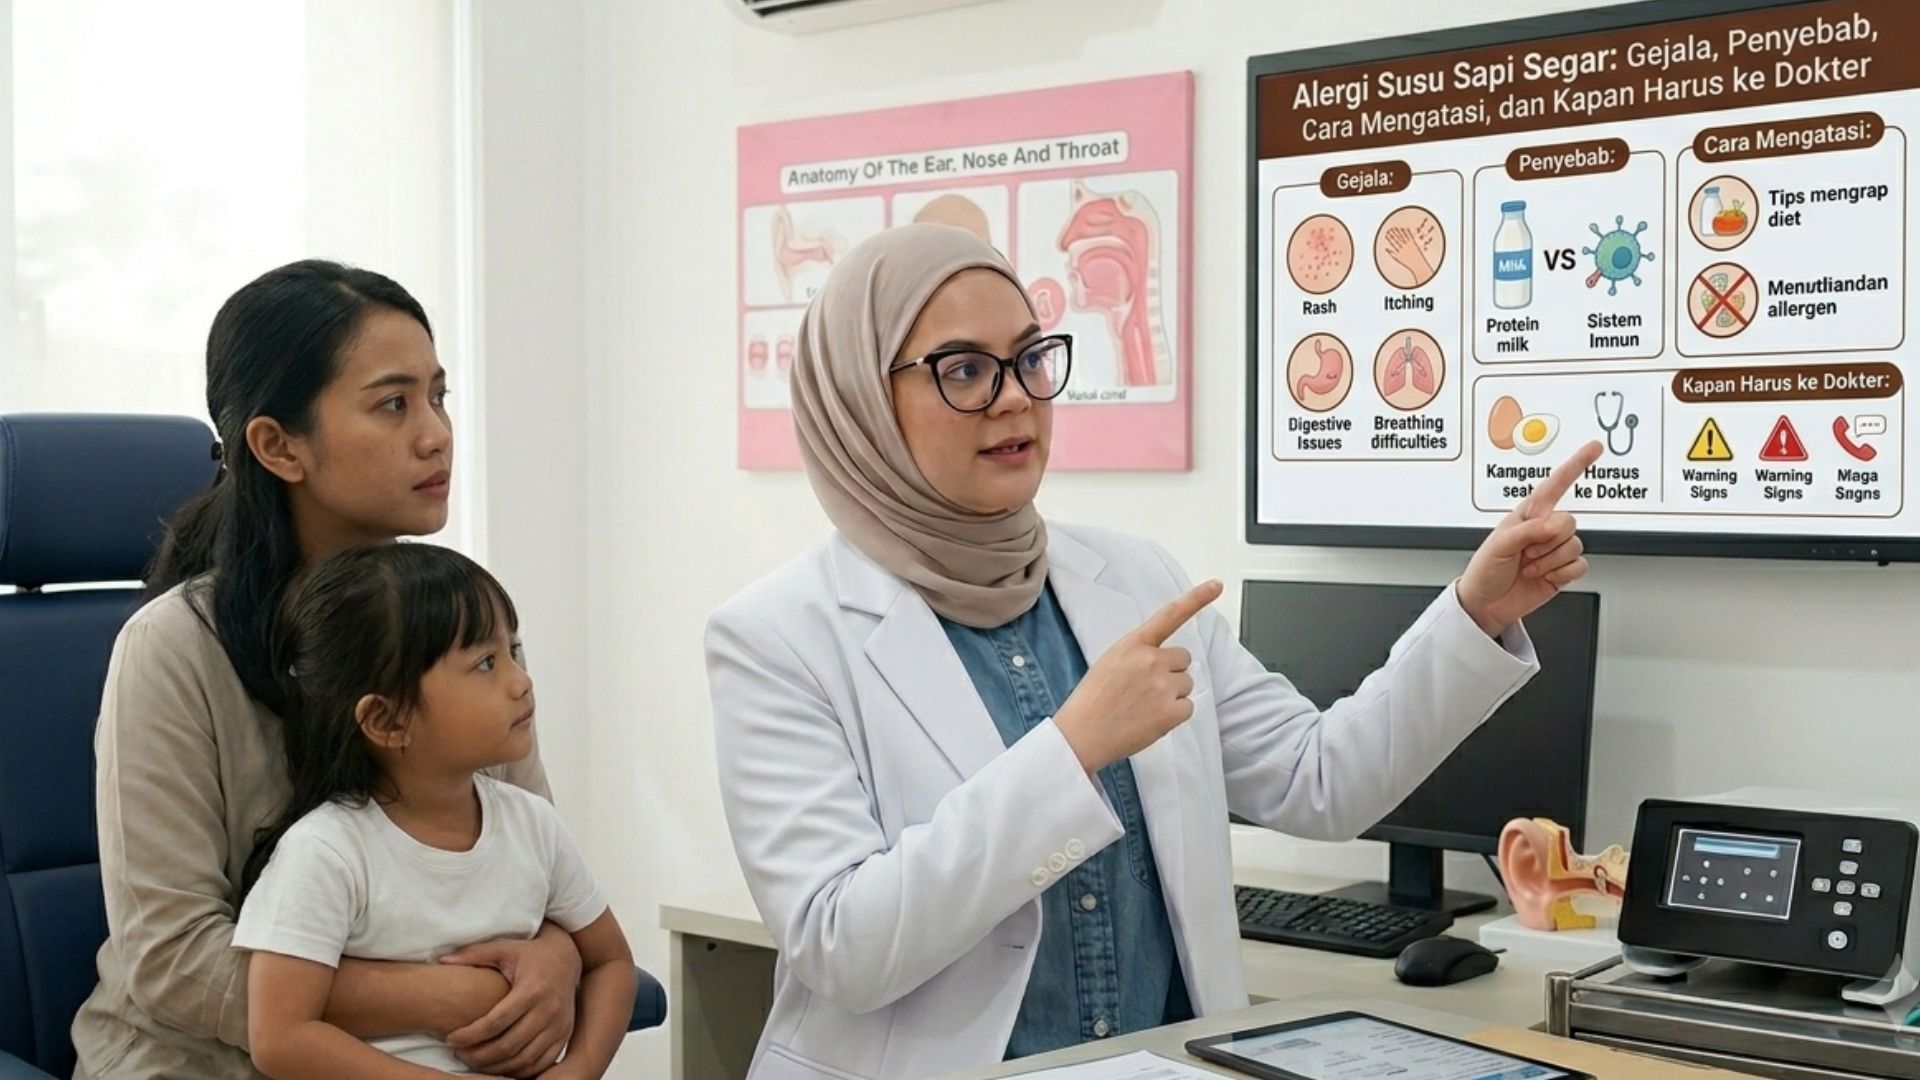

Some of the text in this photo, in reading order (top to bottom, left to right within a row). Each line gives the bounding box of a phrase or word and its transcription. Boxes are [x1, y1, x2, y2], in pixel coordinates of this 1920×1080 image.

[1292, 12, 1878, 111] Alergi Susu Sapi Segar: Gejala, Penyebab,
[1302, 56, 1872, 142] Cara Mengatasi, dan Kapan Harus ke Dokter
[1704, 119, 1872, 155] Cara Mengatasi:
[788, 167, 859, 186] Anatomy
[863, 160, 884, 179] Of
[888, 158, 919, 177] The
[962, 152, 1008, 171] Nose
[1013, 144, 1051, 166] And
[1056, 139, 1120, 162] Throat
[1519, 147, 1616, 173] Penyebab:
[1336, 169, 1394, 193] Gejala:
[1768, 184, 1889, 209] Tips mengrap
[1768, 211, 1801, 227] diet
[1543, 248, 1576, 271] VS
[1302, 299, 1337, 315] Rash
[1384, 294, 1434, 312] Itching
[1767, 301, 1837, 320] allergen
[1486, 316, 1539, 333] Protein
[1587, 313, 1642, 329] Sistem
[1497, 337, 1529, 352] milk
[1682, 372, 1891, 397] Kapan Harus ke Dokter:
[1288, 416, 1352, 435] Digestive
[1373, 415, 1444, 432] Breathing
[1297, 435, 1342, 450] Issues
[1370, 433, 1447, 449] difficulties
[1682, 468, 1738, 485] Warning
[1755, 468, 1813, 485] Warning
[1574, 483, 1649, 499] ke Dokter
[1690, 485, 1728, 501] Signs
[1764, 485, 1803, 502] Signs
